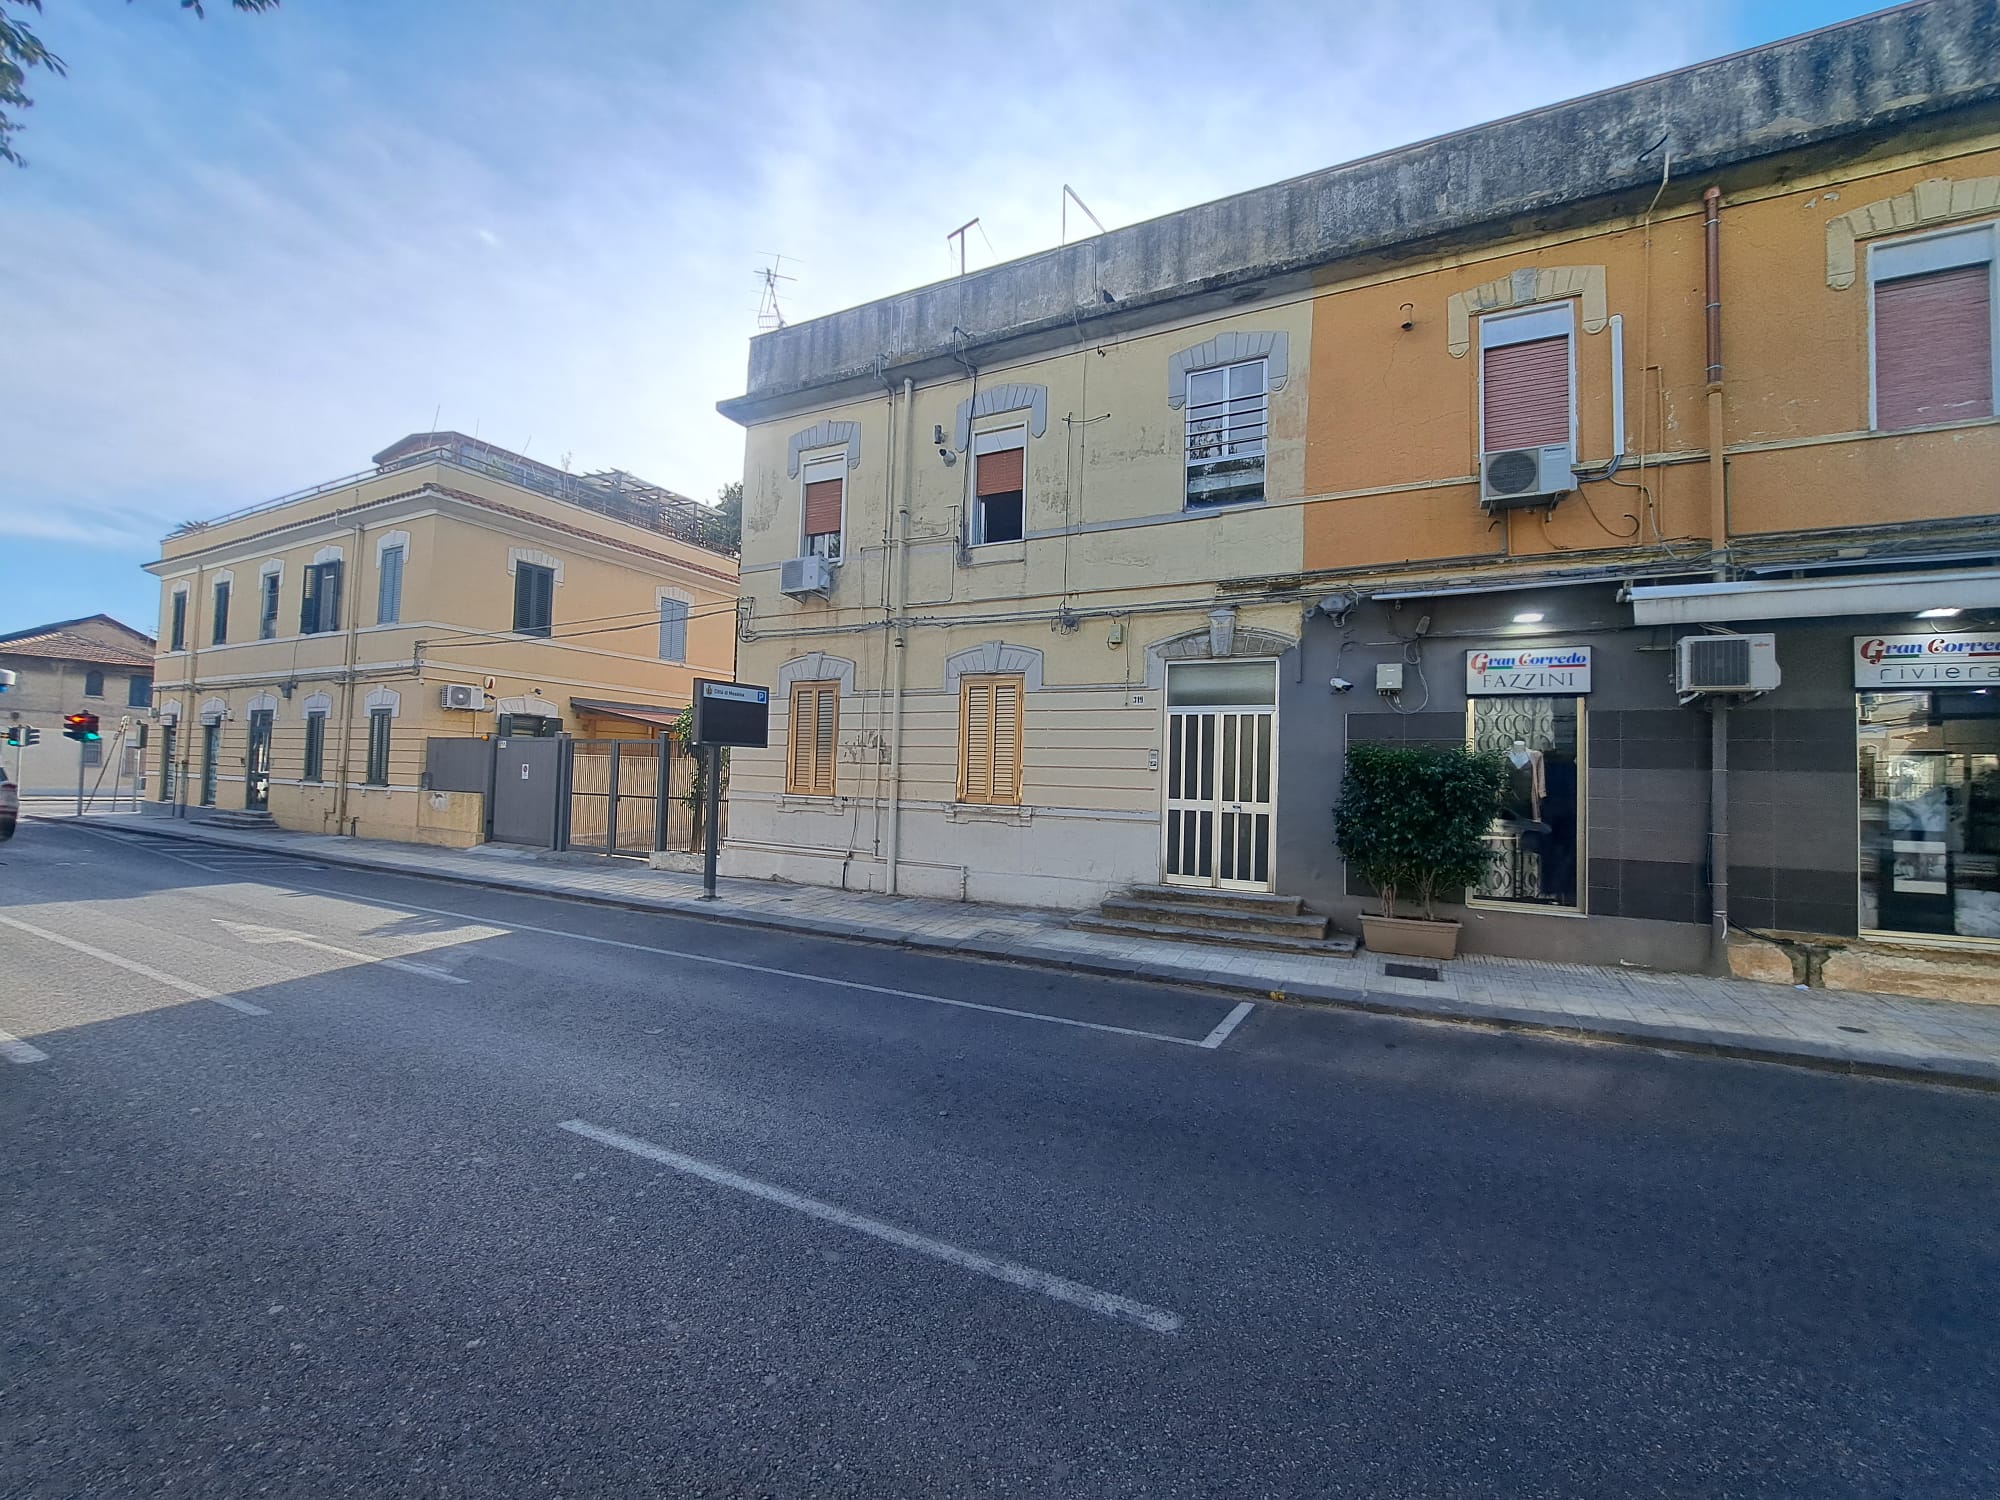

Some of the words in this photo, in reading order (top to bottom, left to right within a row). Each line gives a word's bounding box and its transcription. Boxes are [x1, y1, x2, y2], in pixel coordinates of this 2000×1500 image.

[1471, 652, 1515, 675] Gran
[1519, 652, 1586, 666] Corredo
[1860, 639, 1922, 665] Gran
[1483, 672, 1575, 690] FAZZINI
